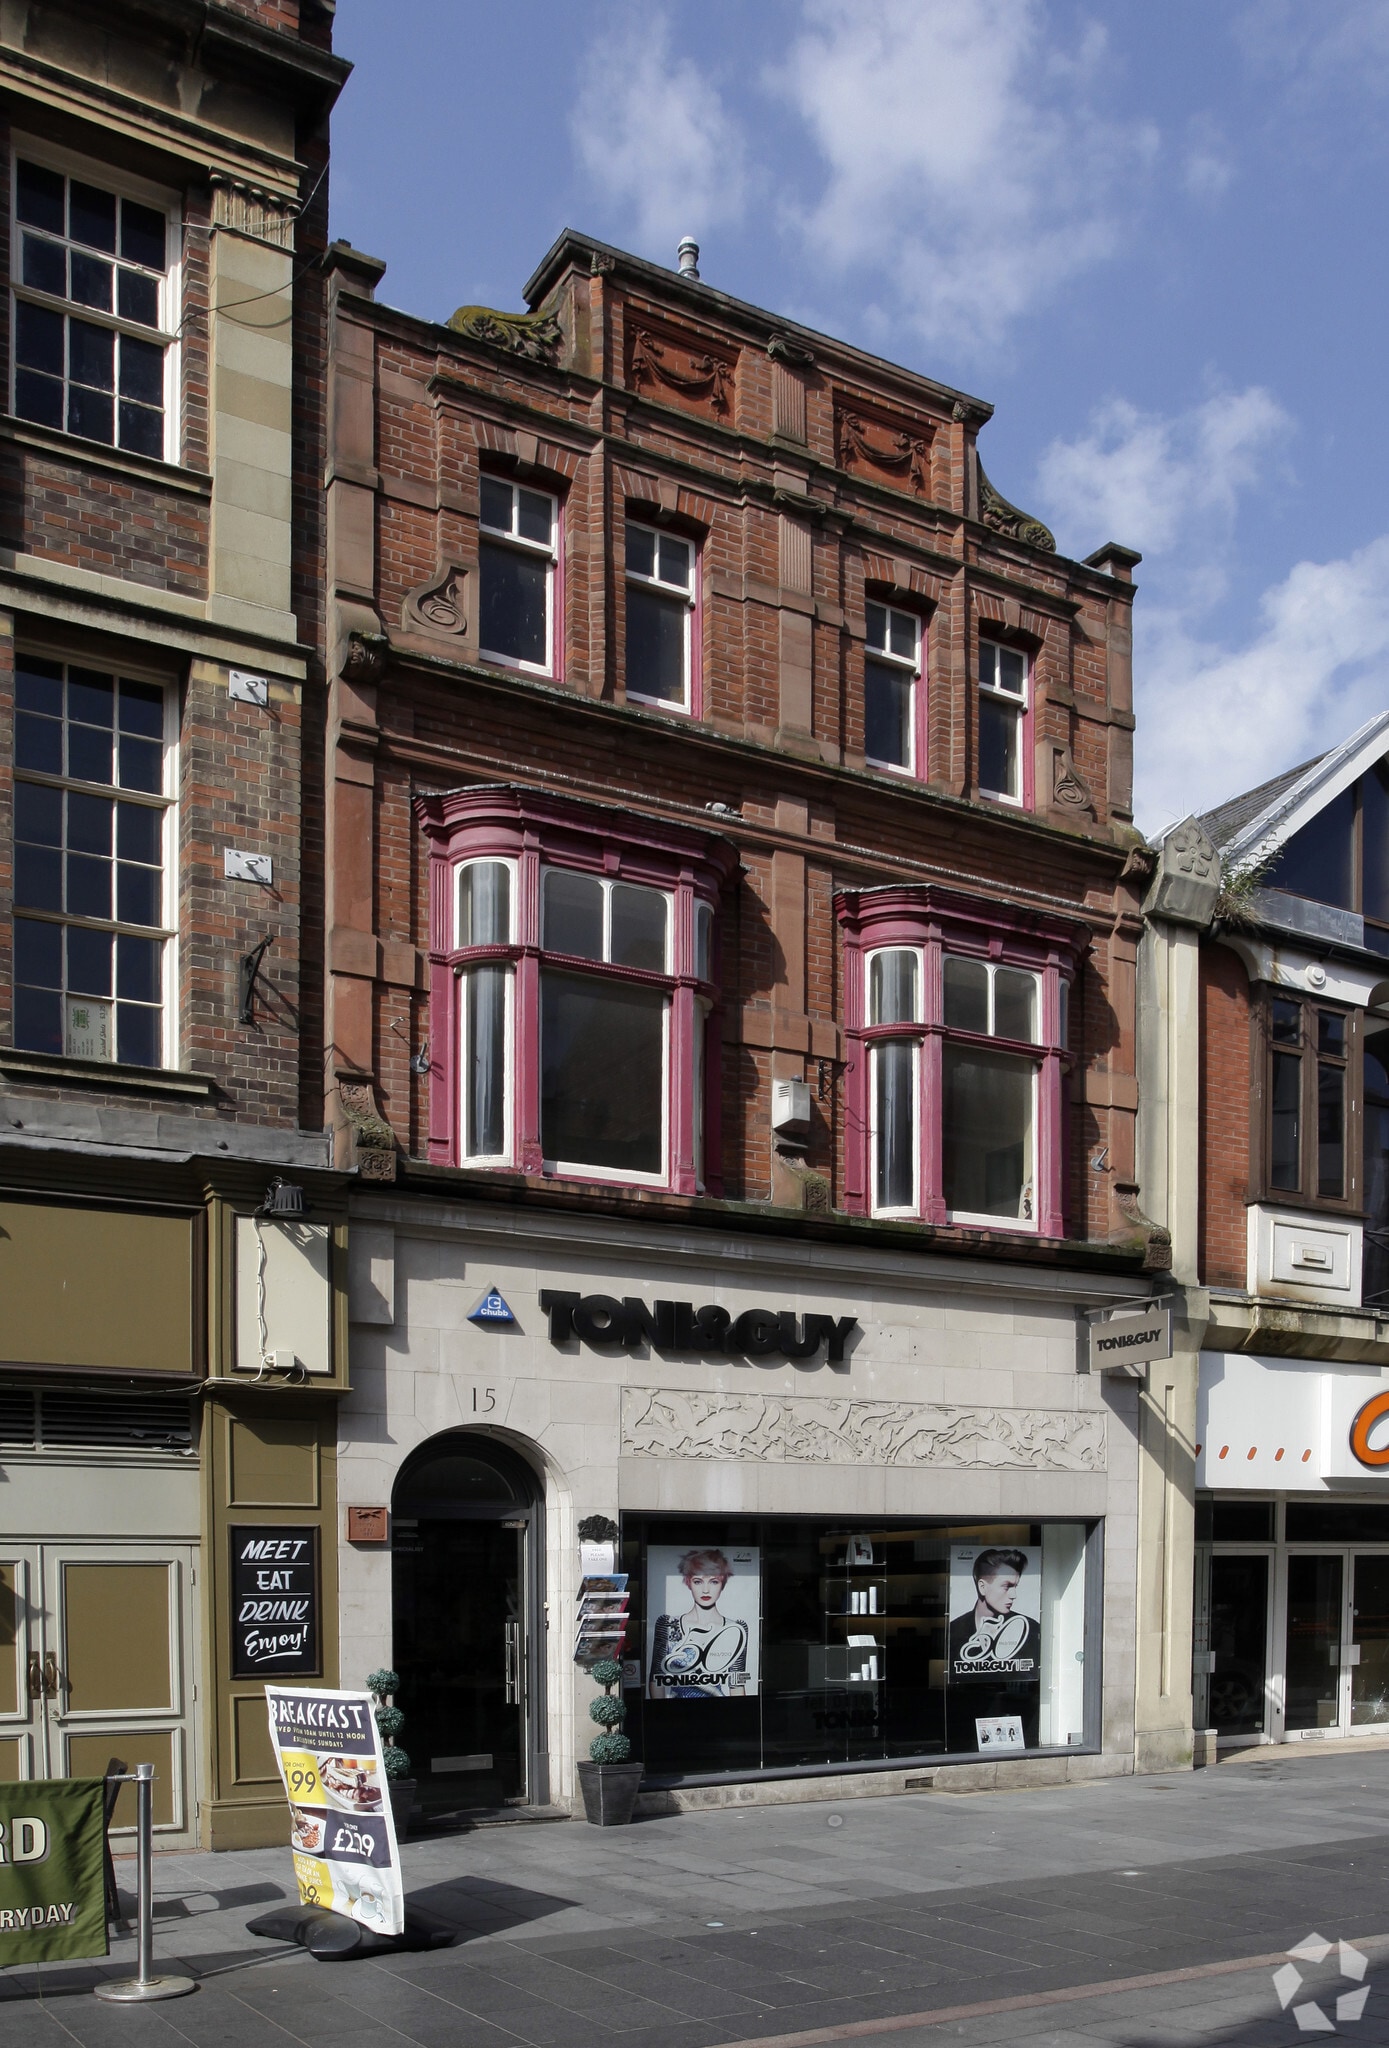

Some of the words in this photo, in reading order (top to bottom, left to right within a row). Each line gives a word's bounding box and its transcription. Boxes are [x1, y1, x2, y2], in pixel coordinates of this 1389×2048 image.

[480, 1308, 509, 1317] Chubb
[538, 1288, 859, 1362] TONI&GUY
[1096, 1328, 1164, 1352] TONI&GUY
[471, 1387, 496, 1413] 15
[240, 1540, 308, 1560] MEET
[256, 1570, 294, 1590] EAT
[238, 1600, 309, 1622] DRINK
[244, 1624, 308, 1657] Enjoy!
[664, 1625, 744, 1673] 50
[961, 1616, 1029, 1660] 50
[955, 1660, 1014, 1673] TONI&GUY
[654, 1673, 729, 1687] TONI&GUY
[270, 1699, 363, 1729] BREAKFAST
[317, 1739, 344, 1748] SUNDAYS
[318, 1731, 335, 1739] UNTIL
[346, 1732, 366, 1740] NOON
